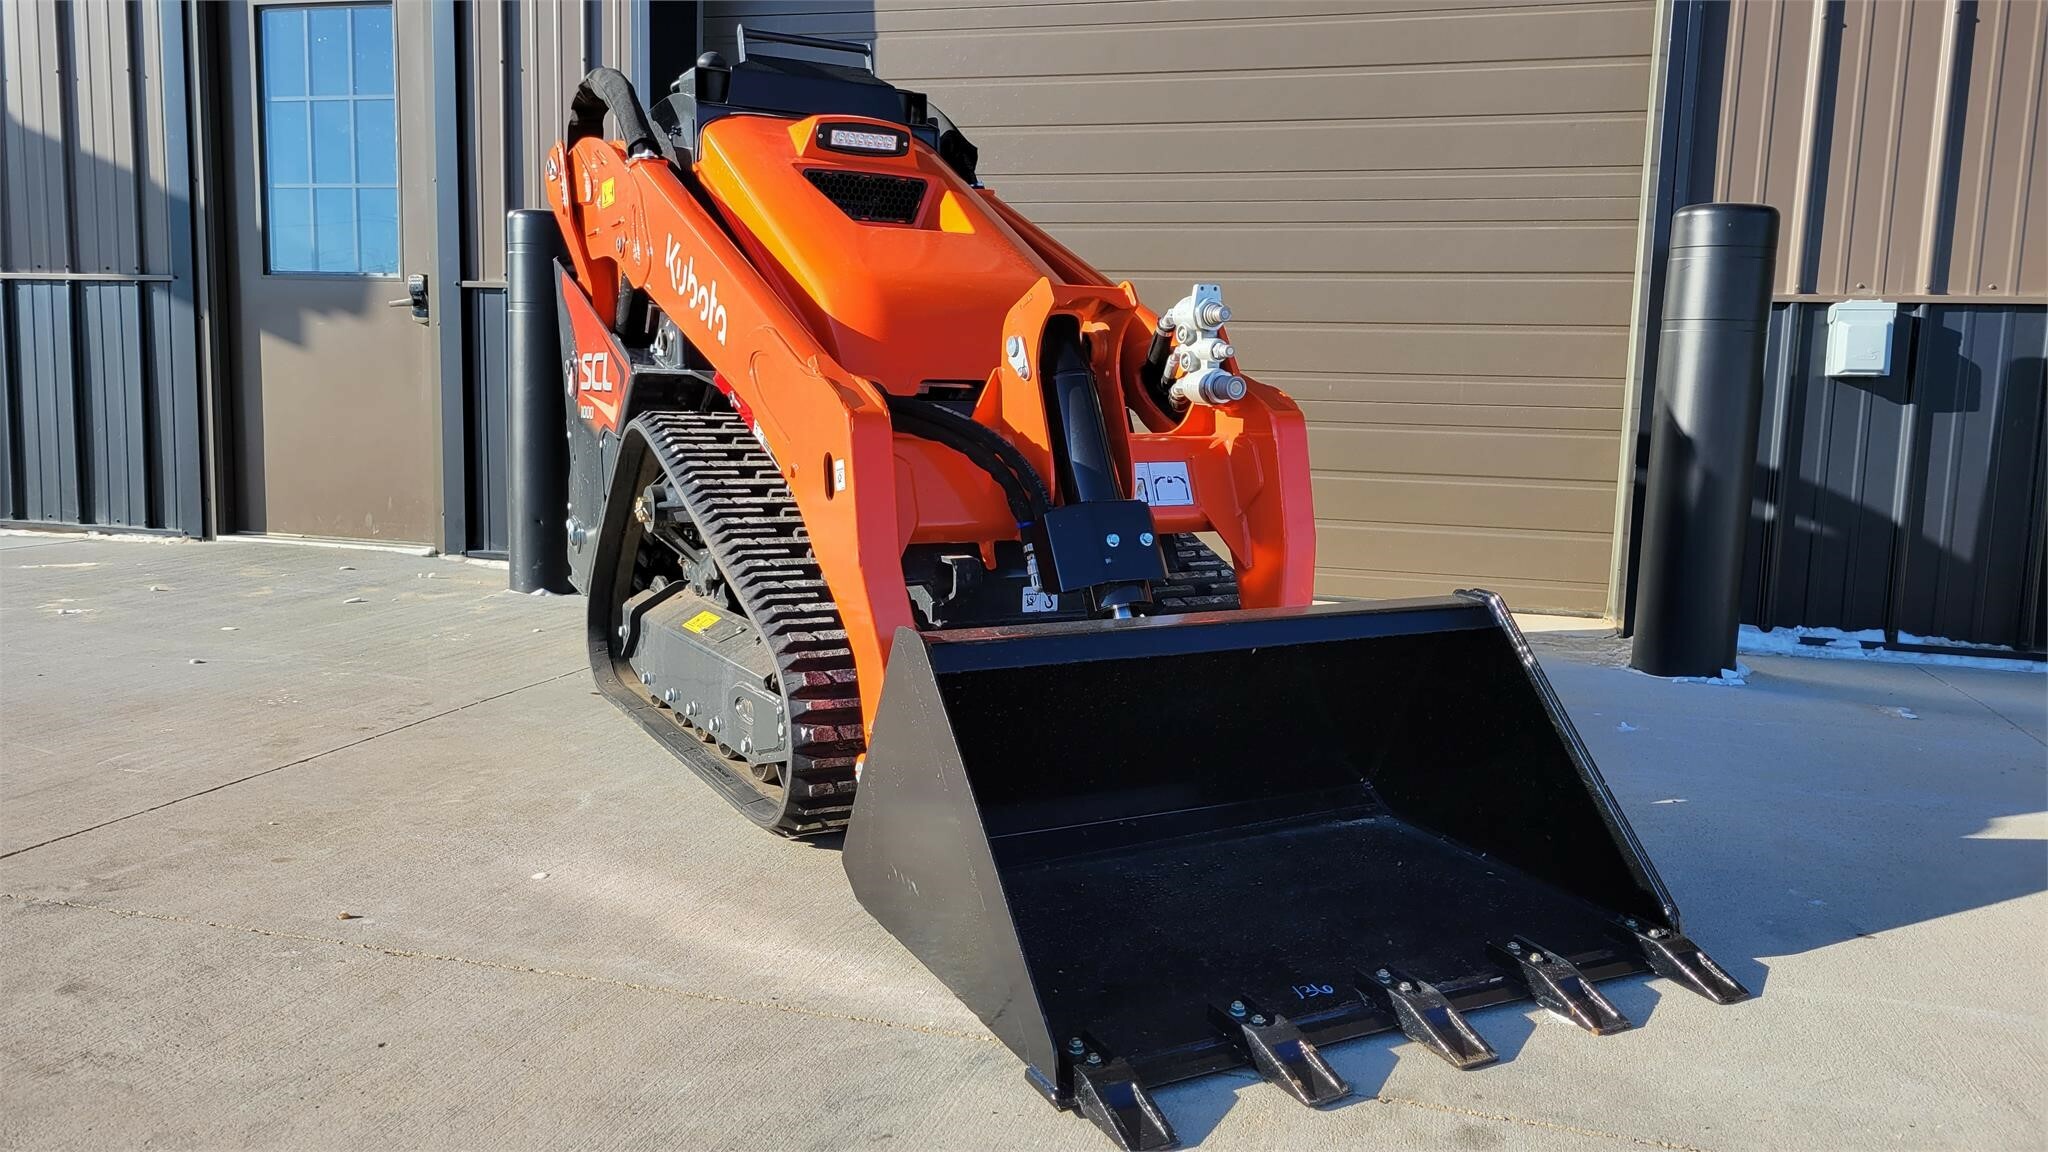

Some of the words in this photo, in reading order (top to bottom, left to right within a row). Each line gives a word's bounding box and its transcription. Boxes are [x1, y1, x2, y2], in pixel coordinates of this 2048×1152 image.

[666, 233, 727, 346] Kubota
[580, 352, 612, 391] SCL
[581, 406, 594, 419] 1000
